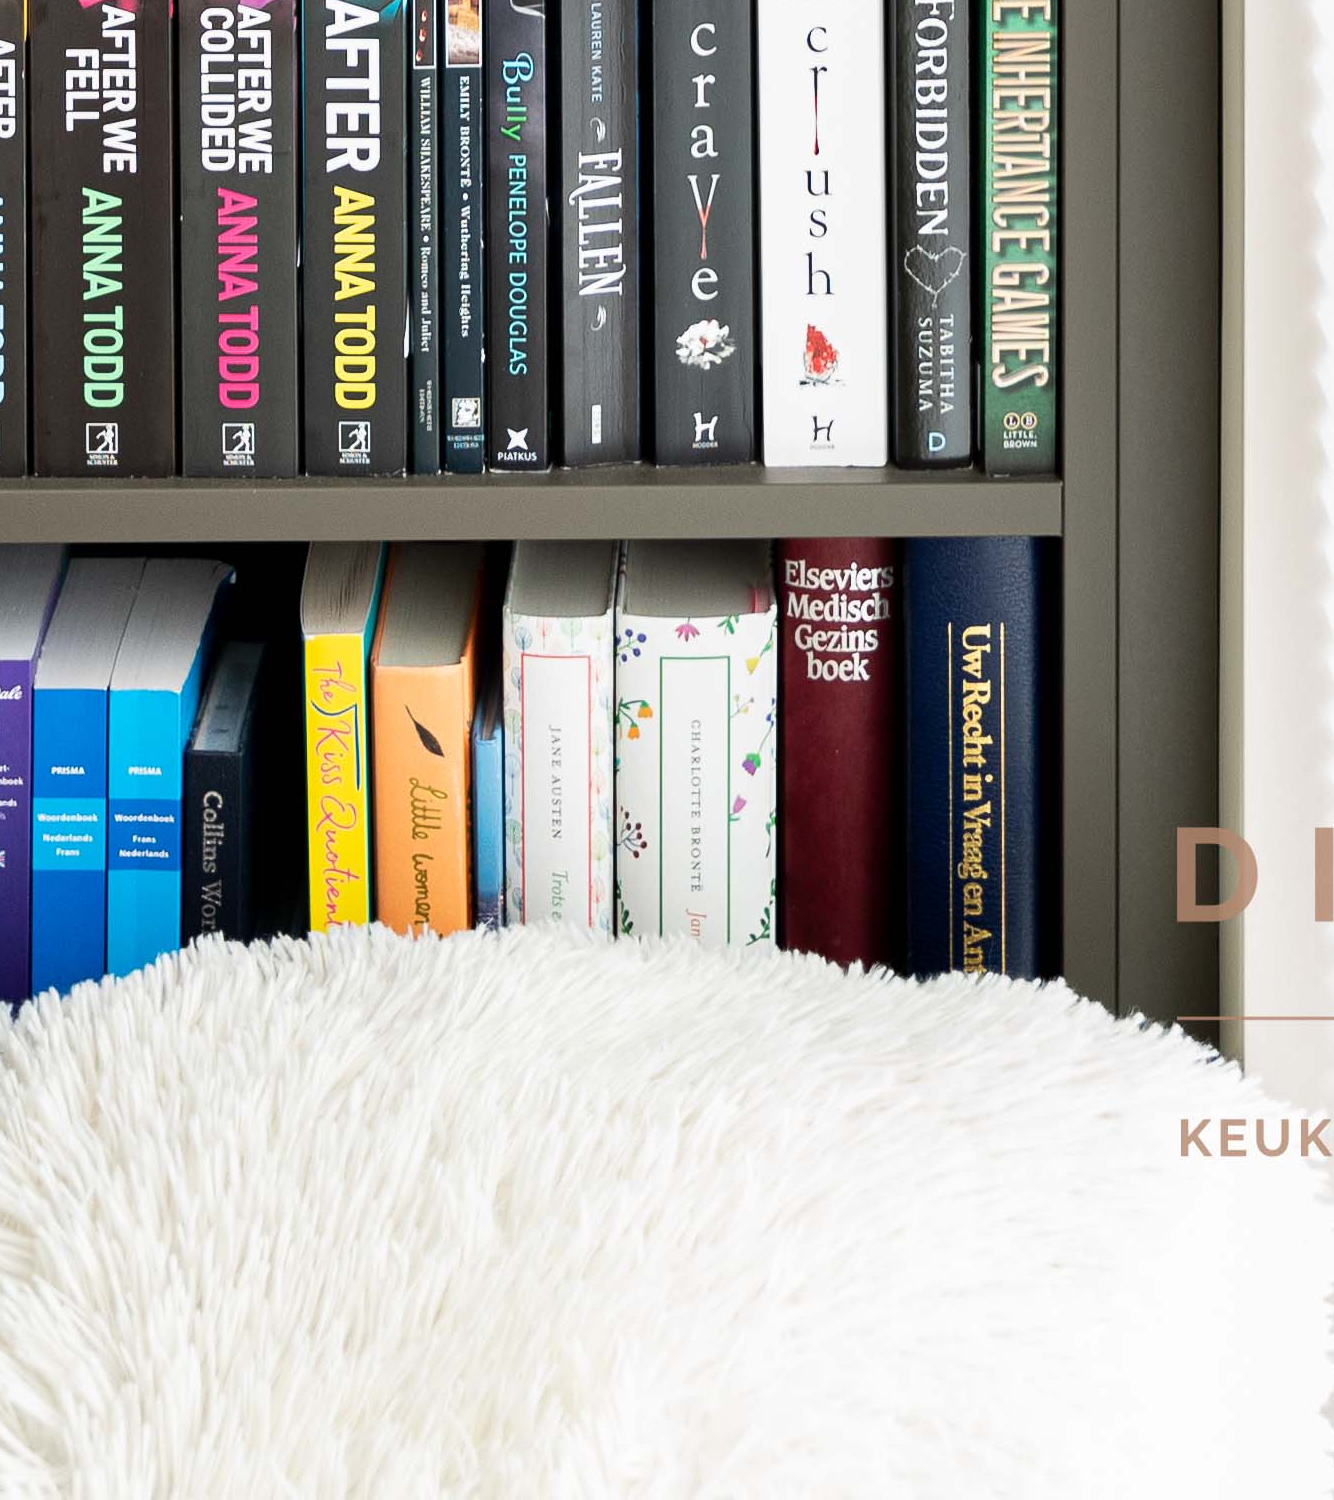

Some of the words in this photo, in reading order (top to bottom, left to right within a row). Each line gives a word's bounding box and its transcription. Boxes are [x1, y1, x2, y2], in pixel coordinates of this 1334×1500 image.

[590, 3, 603, 63] LAUREN
[501, 53, 533, 141] Bully
[590, 67, 603, 102] KATE
[990, 31, 1050, 253] INHERITANCE
[334, 185, 375, 299] ANNA
[508, 154, 527, 266] PENELOPE
[569, 148, 627, 296] FALLEN
[508, 271, 528, 375] DOUGLAS
[990, 263, 1050, 388] GAMES
[334, 306, 376, 409] TODD
[784, 560, 893, 589] Elseviers
[786, 593, 890, 619] Medisch
[794, 625, 878, 652] Gezins
[806, 652, 870, 682] boek
[962, 624, 990, 677] Uw
[313, 661, 356, 701] The
[316, 722, 350, 786] Kiss
[550, 725, 562, 768] JANE
[962, 679, 992, 767] Recht
[128, 767, 162, 776] PRISMA
[963, 774, 993, 800] in
[202, 790, 223, 873] Collins
[410, 778, 448, 839] Little
[551, 775, 562, 839] AUSTEN
[957, 802, 990, 879] Vraag
[412, 853, 434, 925] women
[962, 884, 984, 916] en
